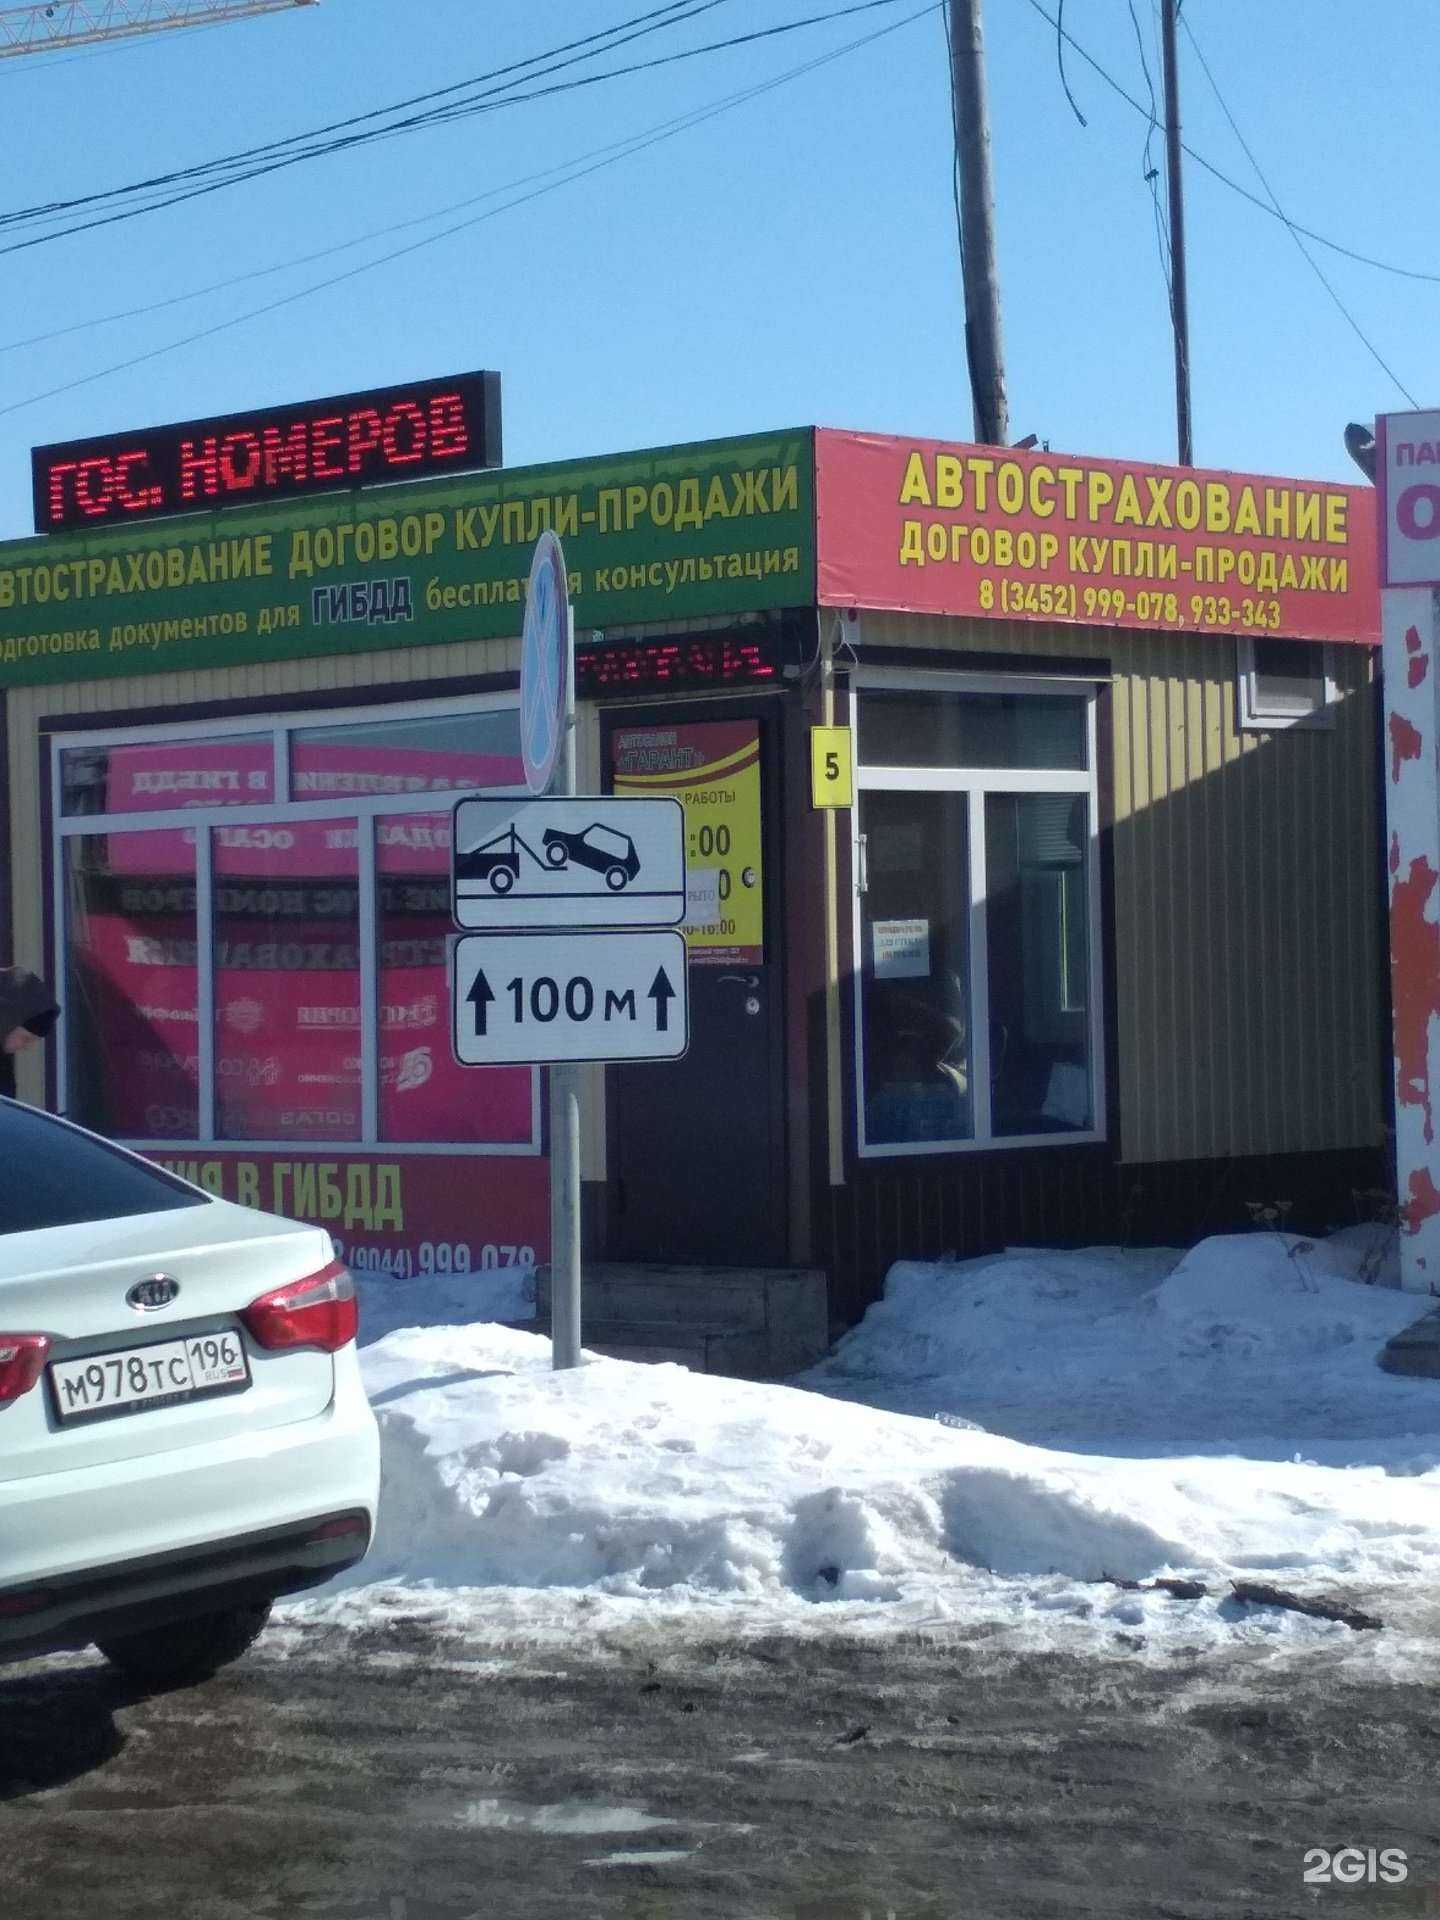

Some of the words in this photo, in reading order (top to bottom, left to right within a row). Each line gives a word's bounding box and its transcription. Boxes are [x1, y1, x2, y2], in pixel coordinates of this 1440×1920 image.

[49, 449, 163, 520] ГОС.
[179, 392, 468, 499] НОМЕРОВ
[900, 452, 1348, 544] АВТОСТРАХОВАНИЕ
[1396, 484, 1440, 541] О
[0, 534, 273, 608] ВТОСТРАХОВАНИЕ
[288, 512, 444, 578] ДОГОВОР
[455, 465, 799, 551] КУПЛИ-ПРОДАЖИ
[899, 519, 1059, 570] ДОГОВОР
[1068, 538, 1349, 594] КУПЛИ-ПРОДАЖИ
[109, 611, 247, 652] документов
[257, 604, 300, 635] для
[312, 576, 414, 638] ГИБДД
[426, 571, 583, 611] бесплатя
[595, 546, 800, 594] консультация
[979, 579, 995, 609] 8
[1001, 581, 1077, 617] (3452)
[1083, 586, 1184, 628] 999-078,
[1190, 596, 1281, 630] 933-343
[824, 752, 840, 781] 5
[684, 790, 736, 805] РАБОТЫ
[506, 976, 594, 1023] 100
[273, 1162, 404, 1232] ГИБДД
[418, 1241, 472, 1275] 999
[190, 1337, 238, 1370] 196
